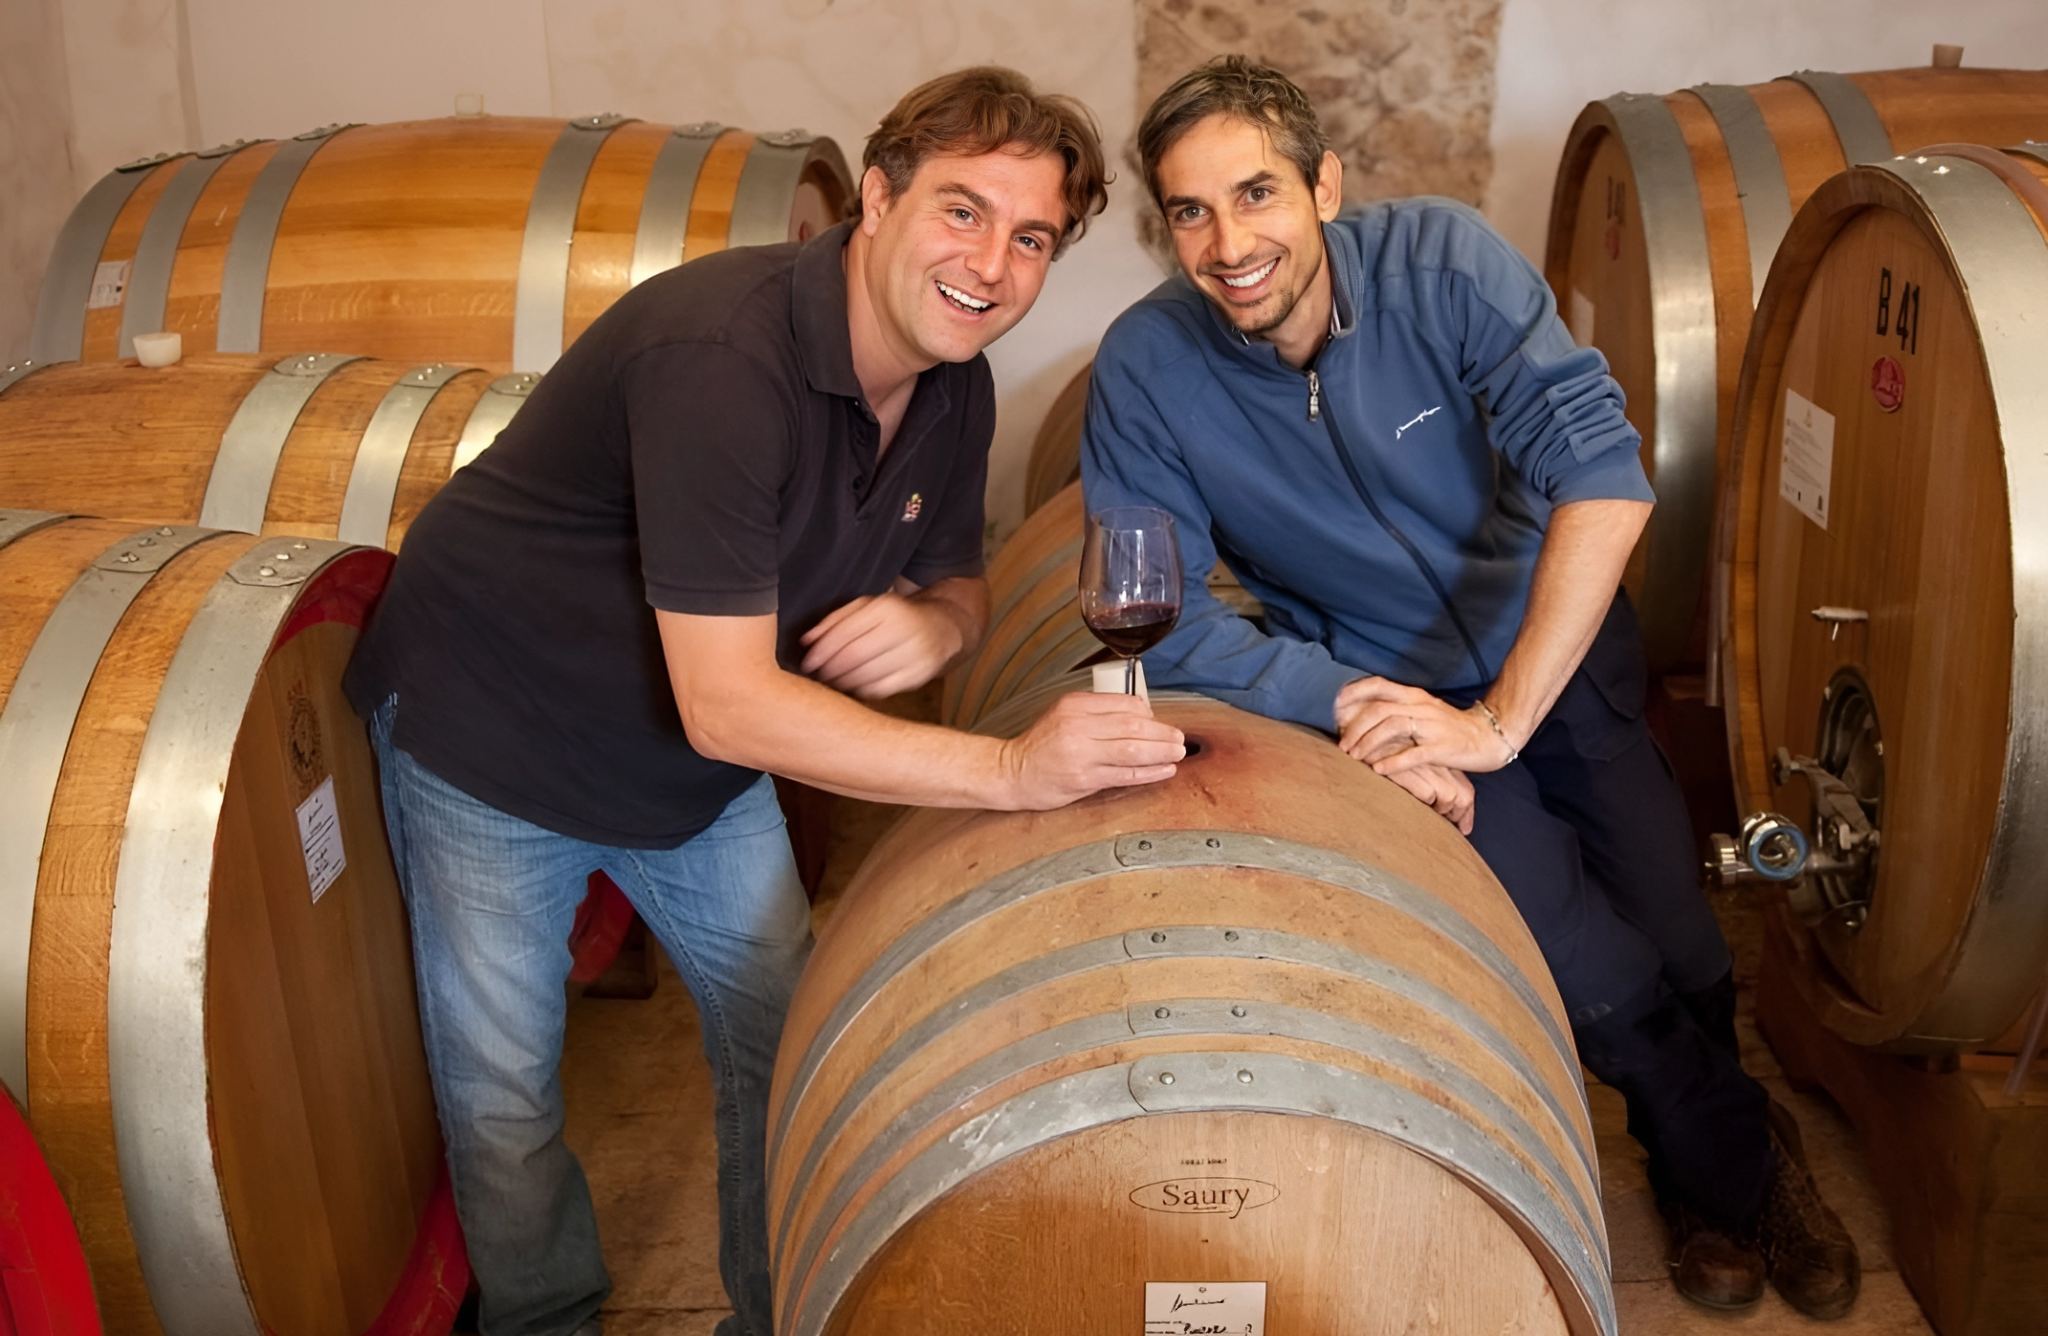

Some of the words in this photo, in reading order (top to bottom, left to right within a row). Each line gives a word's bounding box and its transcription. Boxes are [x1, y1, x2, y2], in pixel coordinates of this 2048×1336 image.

[1876, 267, 1892, 336] B
[1896, 281, 1920, 355] 41
[1162, 1184, 1250, 1220] Saury
